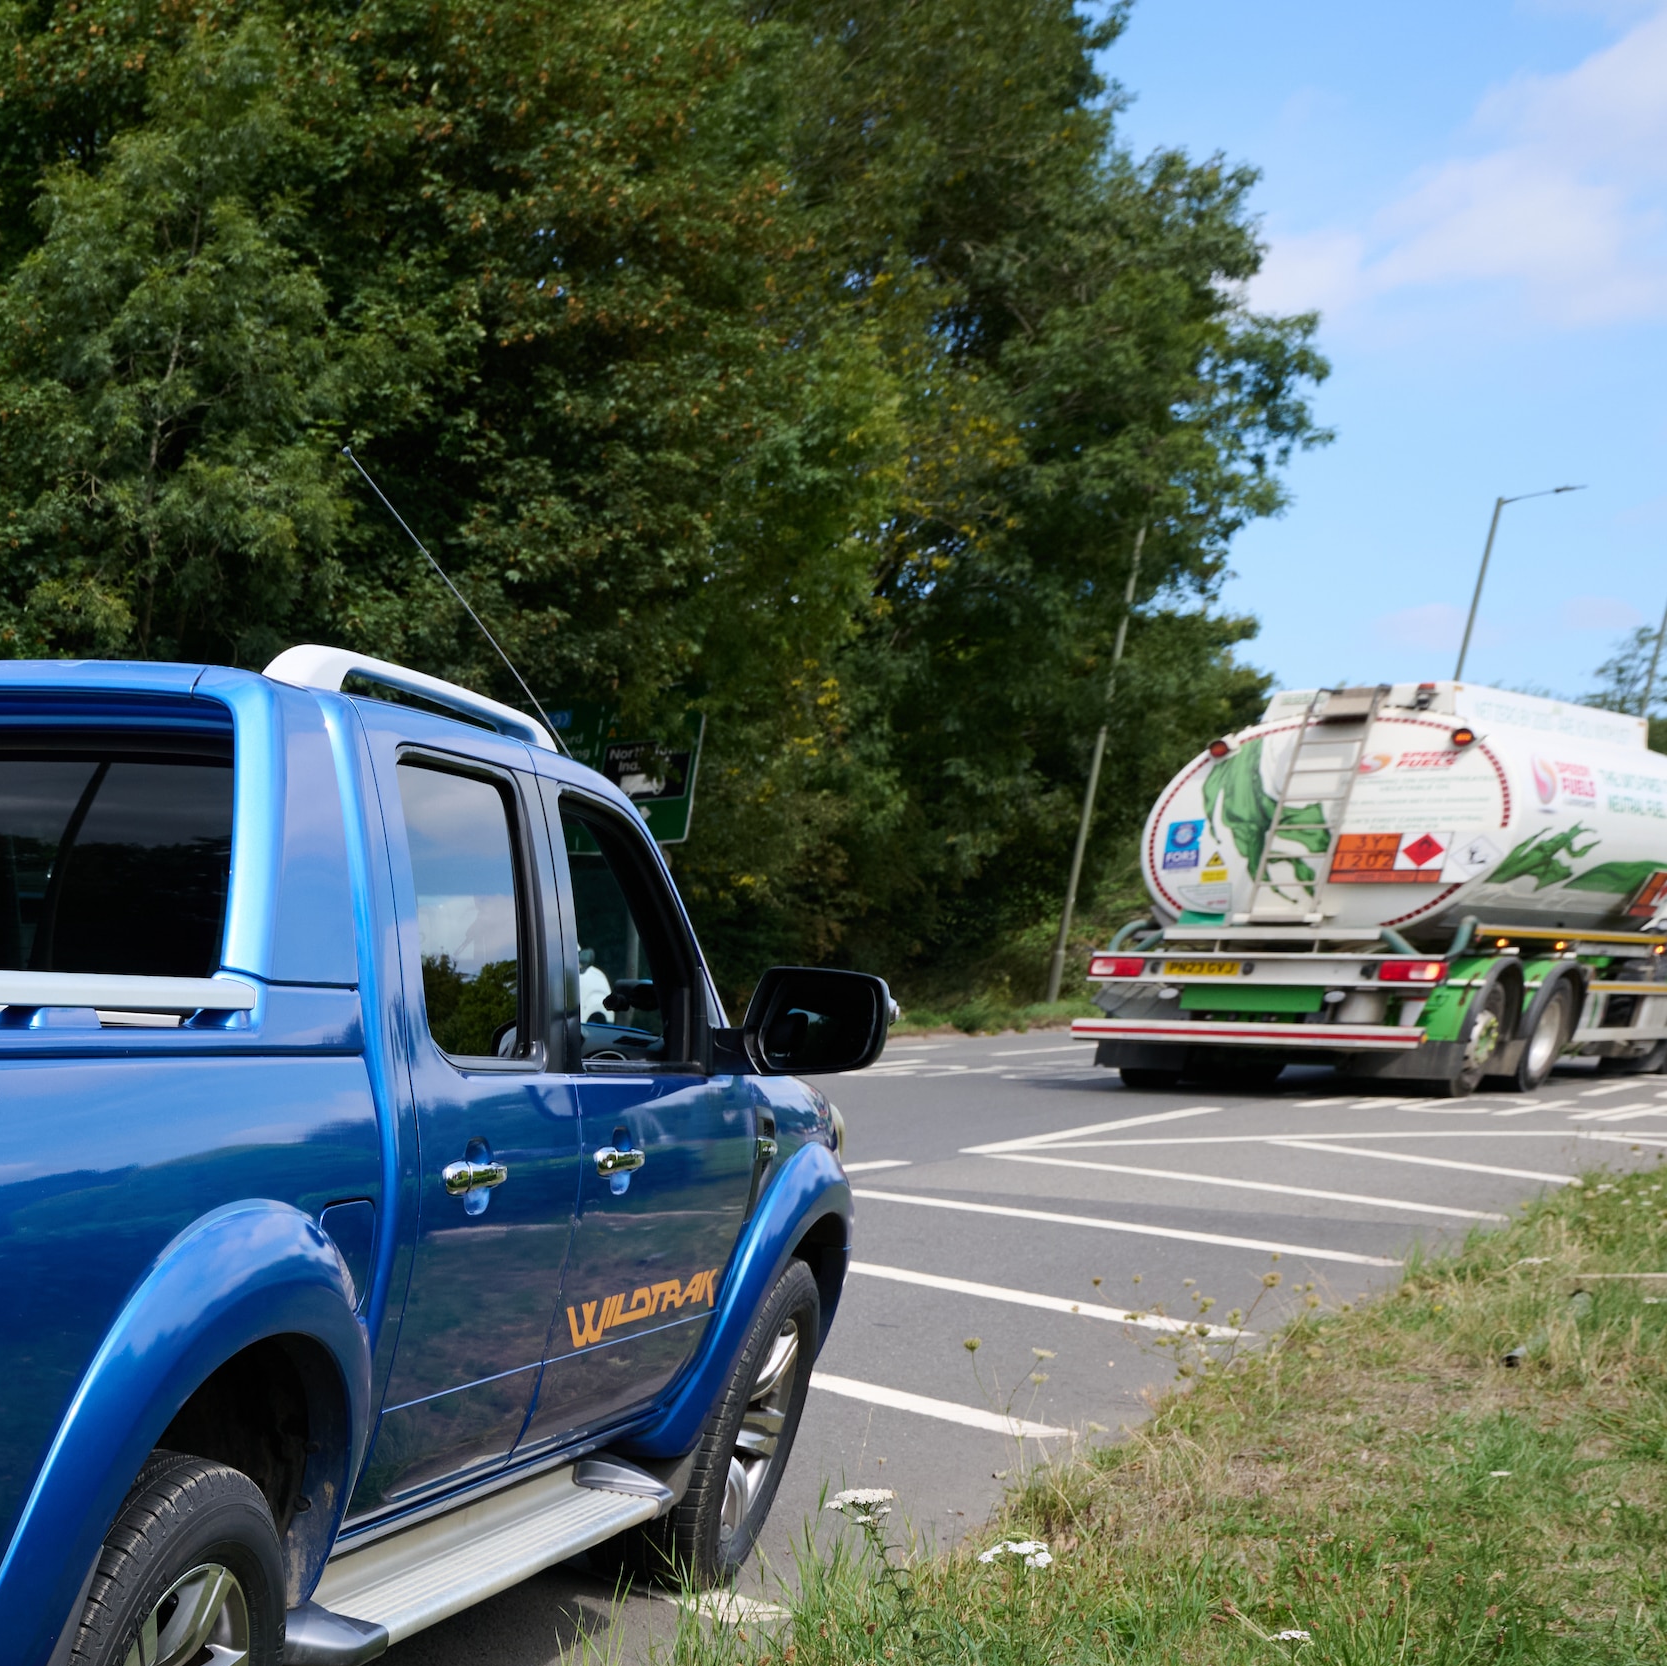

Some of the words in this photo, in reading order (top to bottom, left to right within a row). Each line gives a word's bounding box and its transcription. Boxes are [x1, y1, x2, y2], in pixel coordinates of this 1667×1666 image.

[1396, 758, 1457, 768] FUELS
[1165, 850, 1198, 863] FORS
[1337, 853, 1394, 868] 1202
[566, 1268, 718, 1349] WILDTRAK
